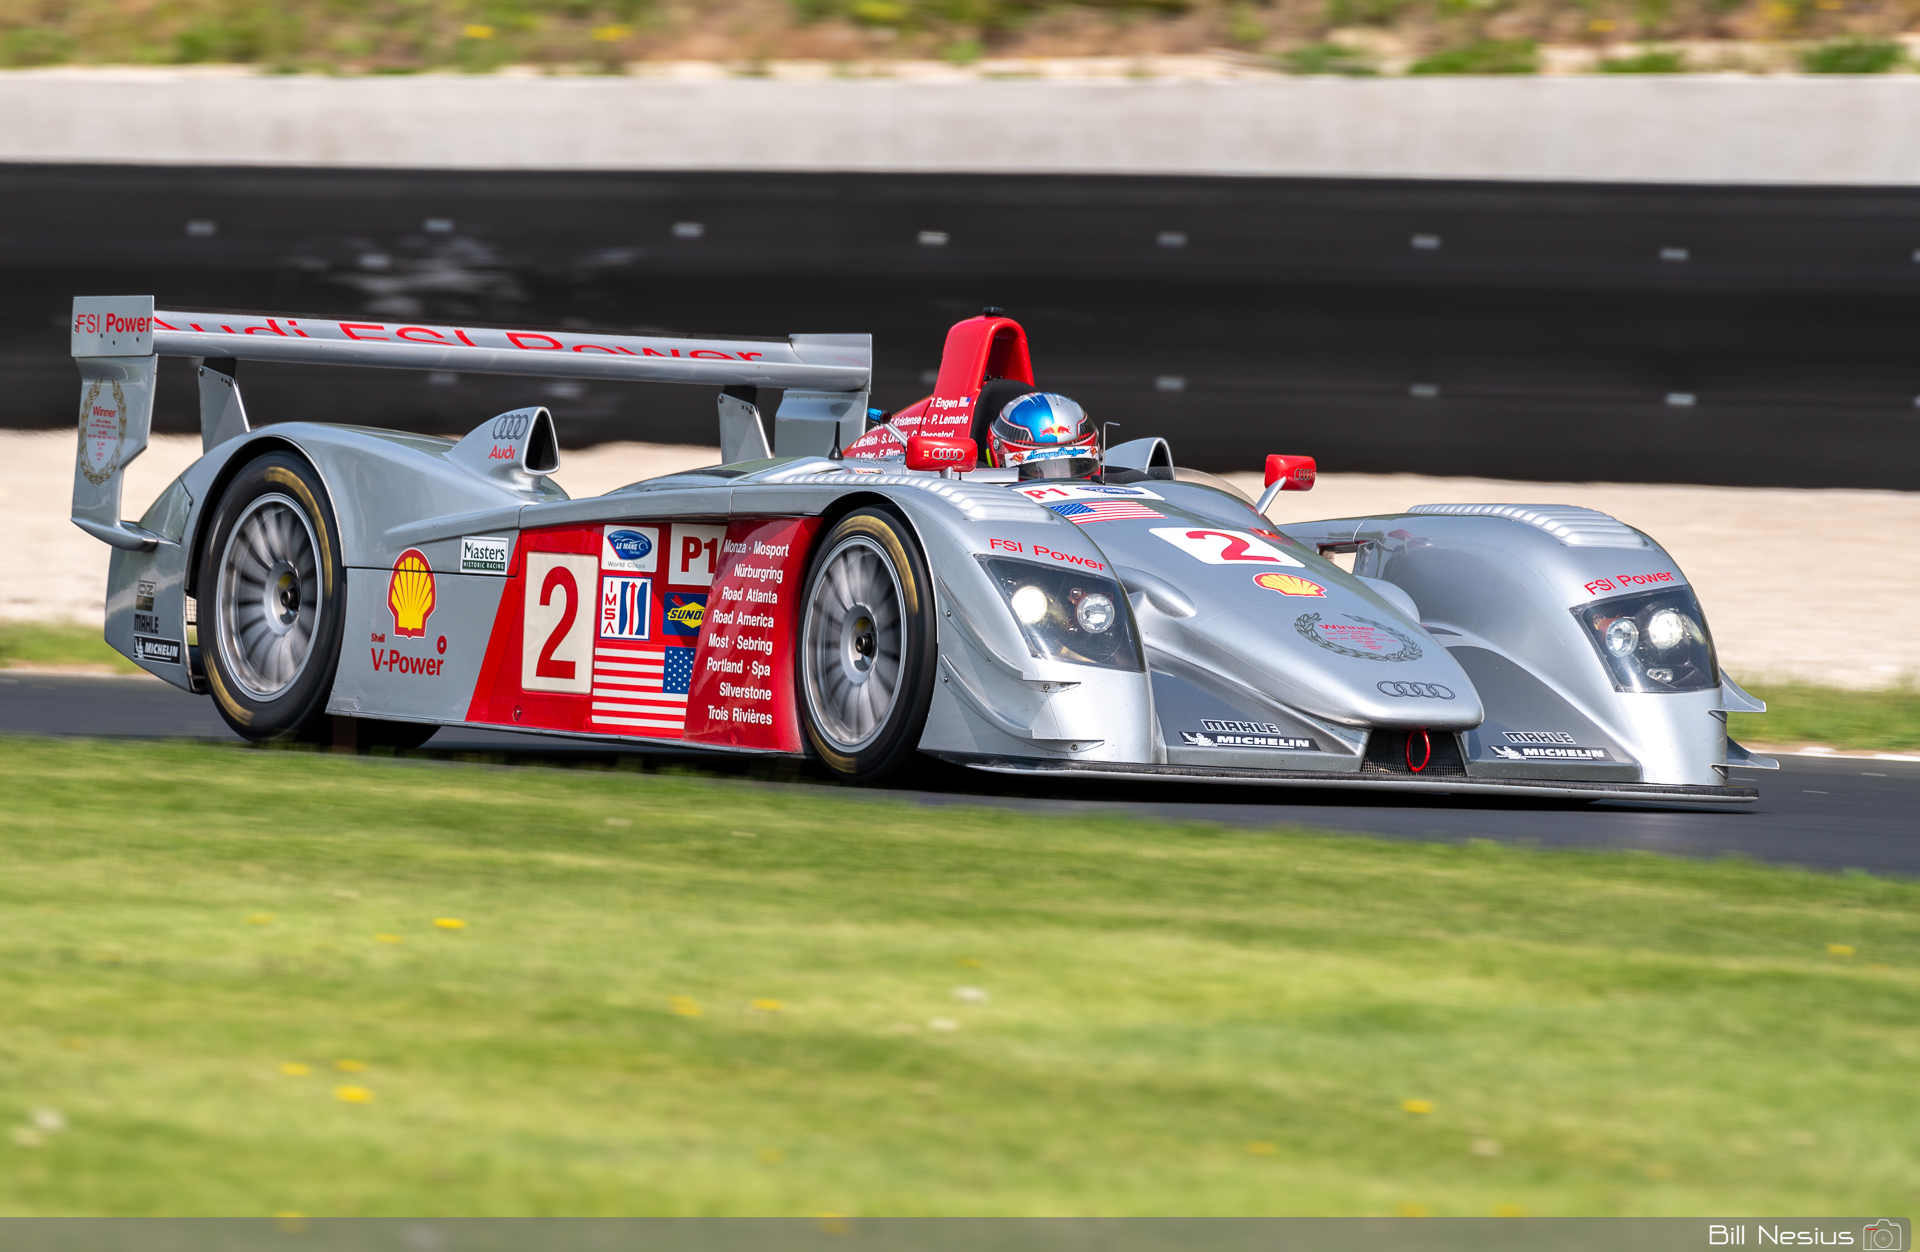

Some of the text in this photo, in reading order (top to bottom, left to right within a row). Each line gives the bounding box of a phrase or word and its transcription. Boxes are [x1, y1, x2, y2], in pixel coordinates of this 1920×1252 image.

[76, 312, 152, 334] FSI Power
[92, 406, 116, 418] Winner
[936, 397, 958, 410] Engen
[488, 444, 516, 460] Audi
[1023, 488, 1070, 500] P1
[464, 542, 505, 560] Masters
[616, 542, 638, 550] LE MANS
[681, 536, 718, 574] P1
[724, 539, 790, 559] Monza Mosport
[990, 538, 1106, 571] FSI Power
[1186, 530, 1282, 562] 2
[486, 562, 504, 570] RACING
[734, 564, 784, 584] Nürburgring
[1584, 570, 1675, 596] FSI Power
[722, 586, 778, 604] Road Atlanta
[604, 580, 617, 634] IMSA
[134, 614, 159, 634] MAHLE
[535, 566, 579, 680] 2
[712, 610, 774, 628] Road America
[1318, 624, 1375, 632] Winner
[371, 632, 386, 643] Shell
[708, 633, 773, 656] Most Sebring
[145, 642, 179, 657] MICHELIN
[371, 648, 444, 676] V-Power
[706, 657, 771, 679] Portland Spa
[719, 682, 772, 701] Silverstone
[707, 705, 773, 725] Trois Rivières
[1200, 718, 1281, 735] MAHLE
[1216, 735, 1310, 748] MICHELIN
[1502, 731, 1577, 744] MAHLE
[1522, 748, 1605, 758] MICHELIN
